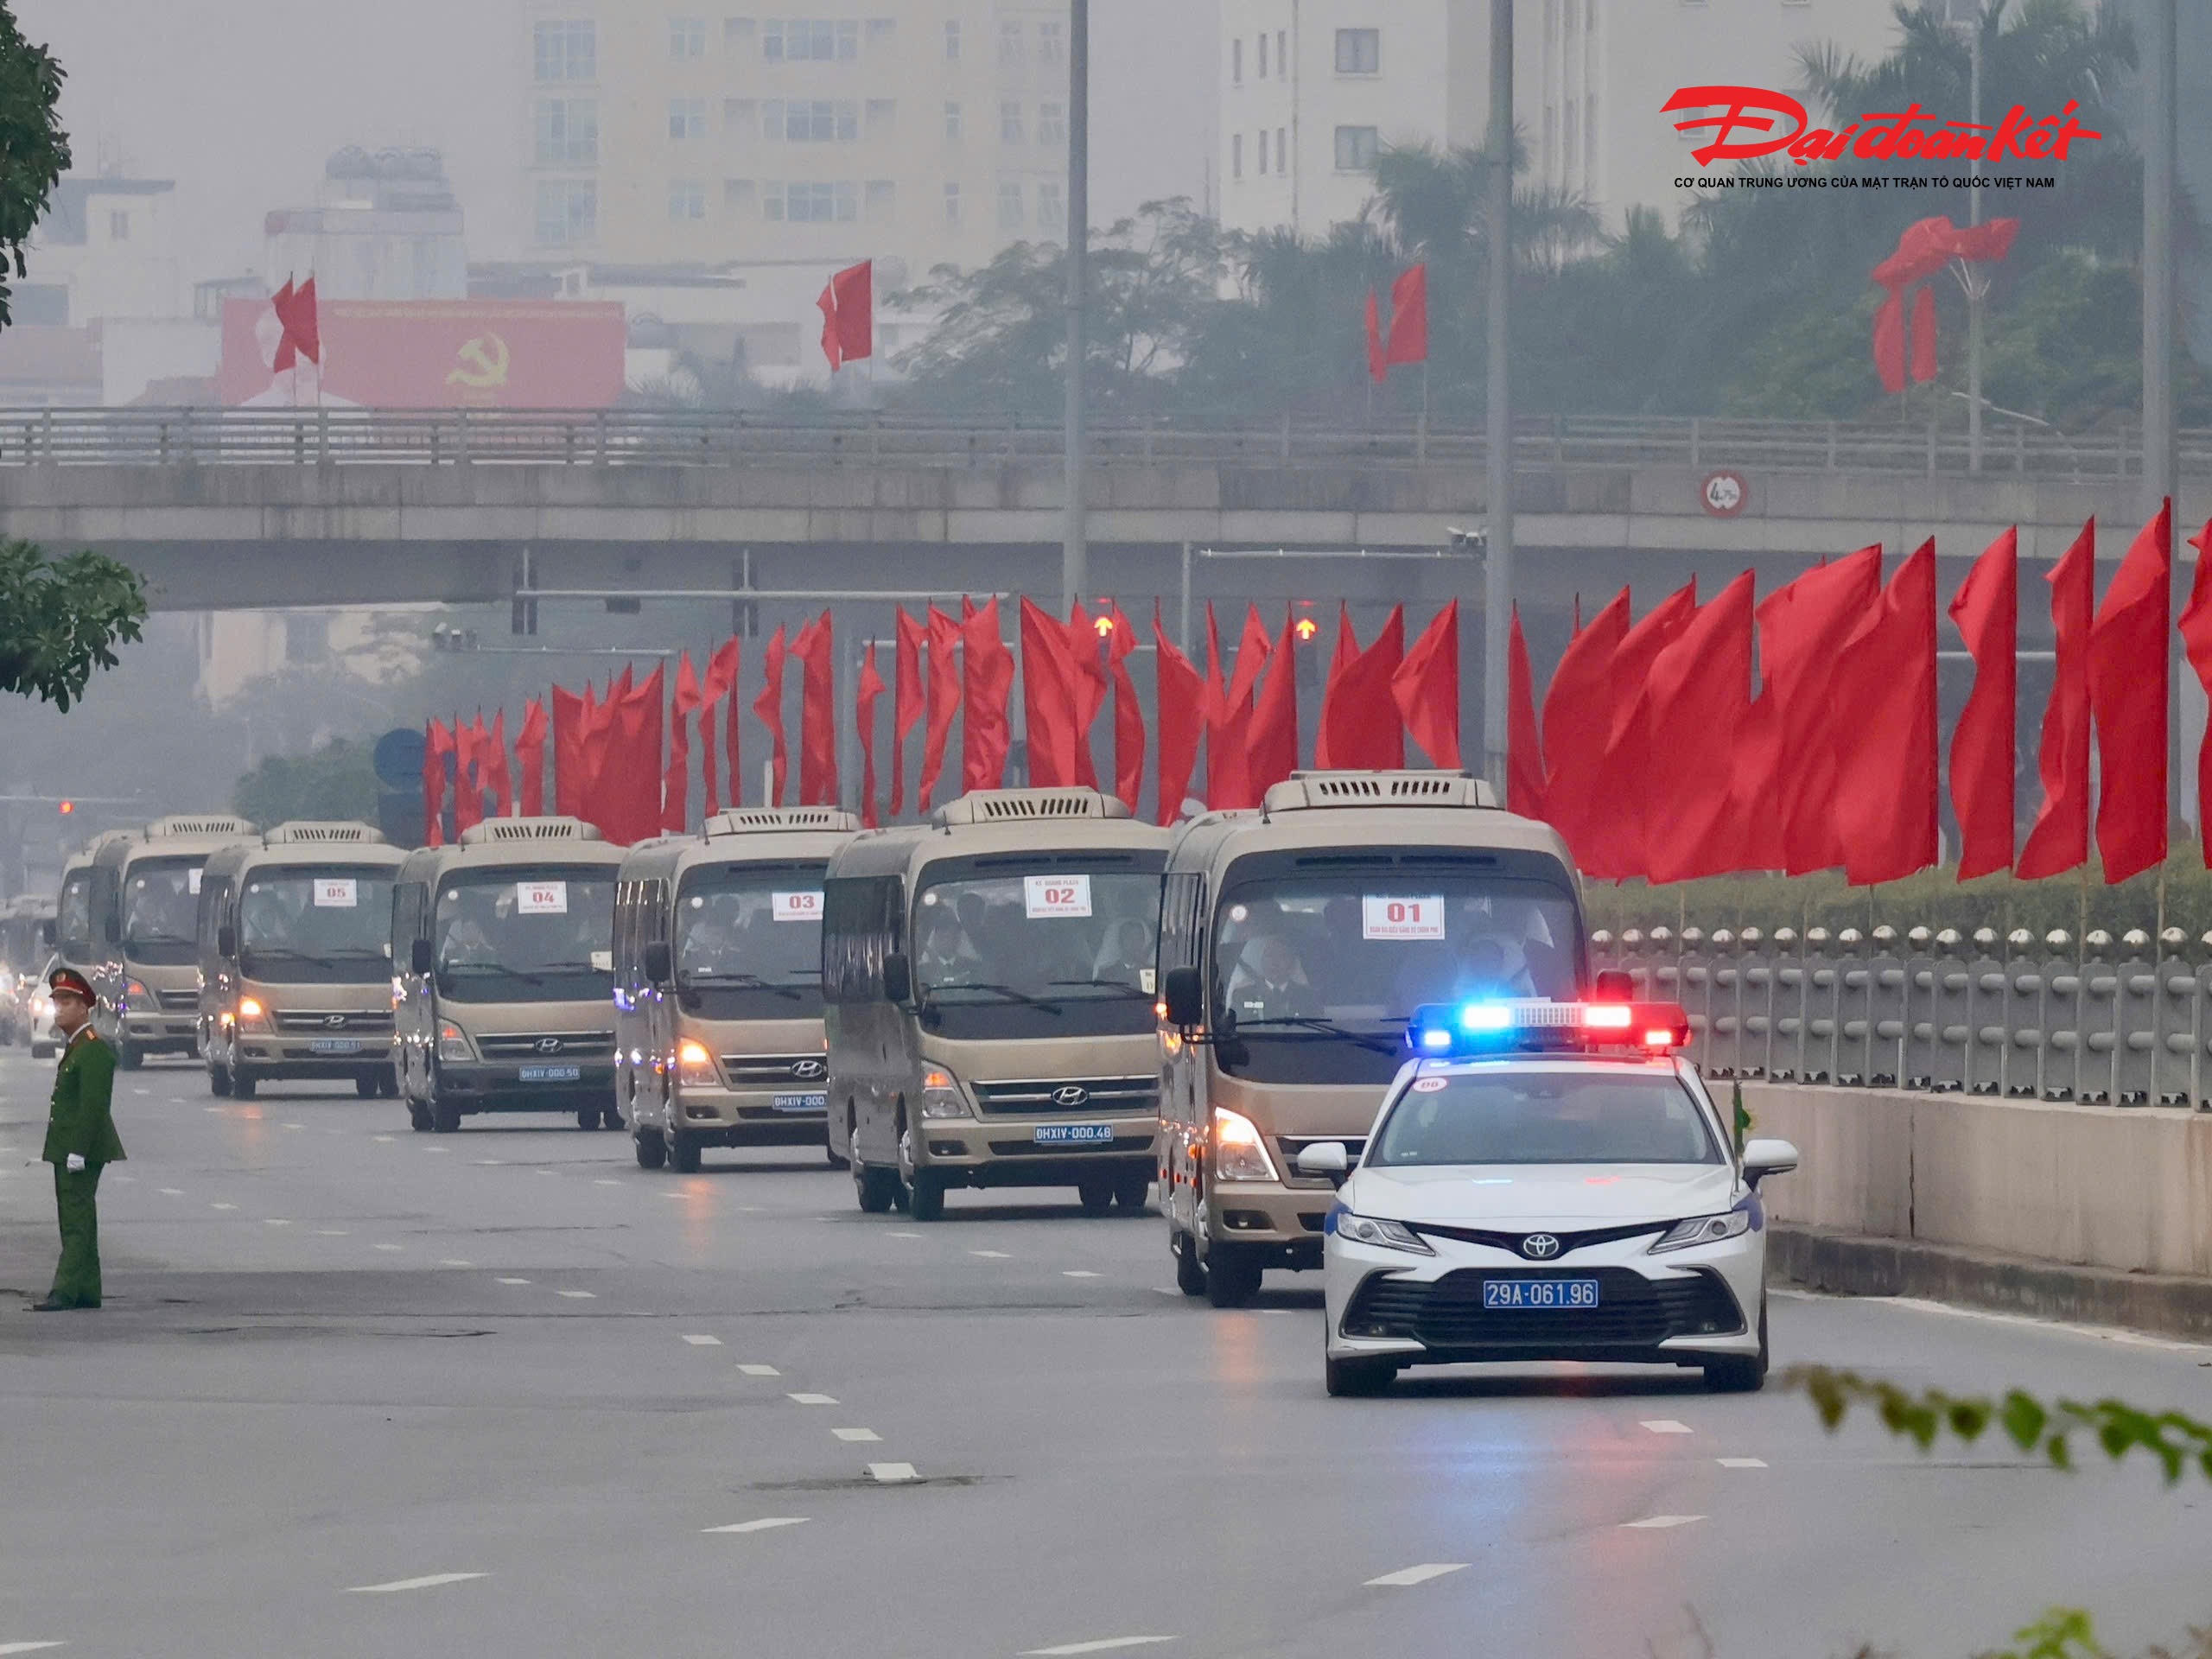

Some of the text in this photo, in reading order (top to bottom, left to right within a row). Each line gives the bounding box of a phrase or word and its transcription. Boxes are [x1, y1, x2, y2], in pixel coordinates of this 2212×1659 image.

[532, 891, 555, 903] 04
[789, 894, 815, 909] 03
[1045, 887, 1076, 905] 02
[1387, 902, 1421, 923] 01
[1487, 1283, 1594, 1306] 29A-061.96
